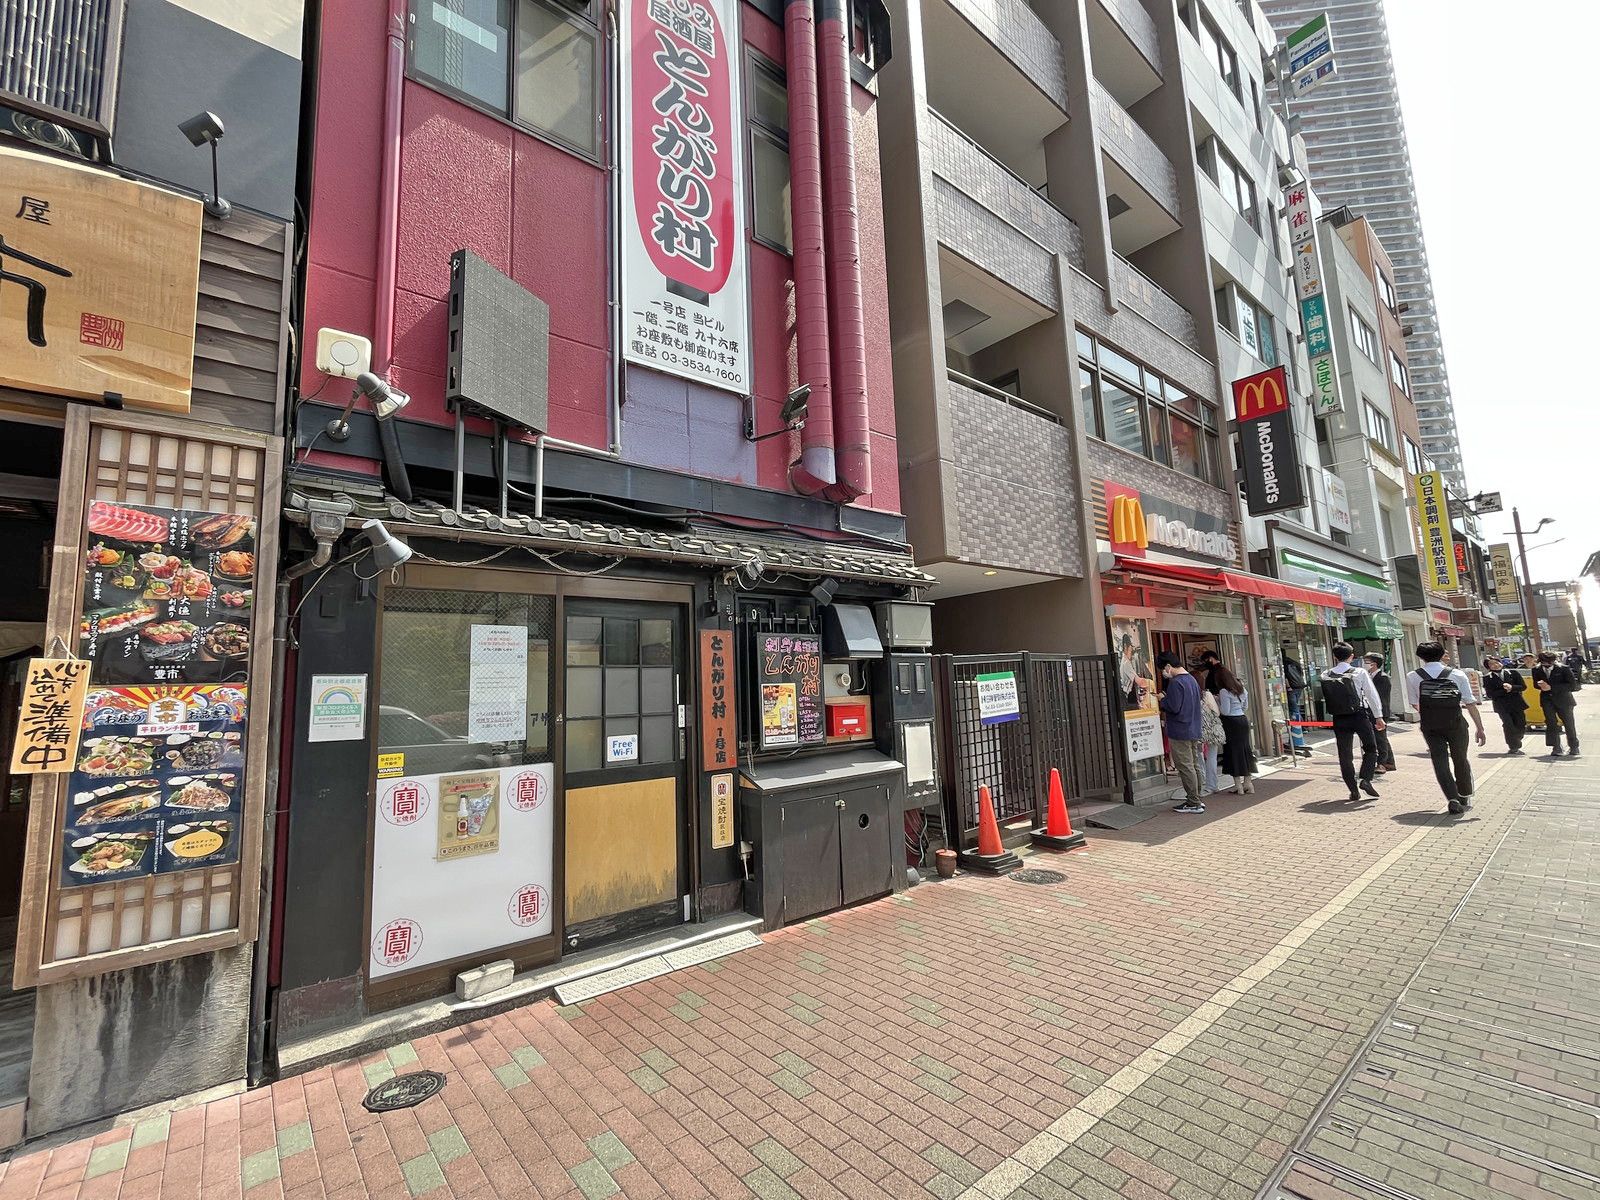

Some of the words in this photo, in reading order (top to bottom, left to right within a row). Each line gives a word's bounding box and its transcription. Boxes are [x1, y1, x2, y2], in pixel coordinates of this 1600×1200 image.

[1299, 78, 1314, 90] ATM
[652, 32, 716, 270] とんがり村
[16, 195, 52, 226] 屋
[1288, 188, 1308, 229] 麻雀
[1295, 229, 1310, 241] 2F
[633, 311, 689, 337] 一階、二階
[695, 328, 740, 354] 九十六席
[650, 300, 686, 320] 一号店
[693, 312, 725, 333] 当ビル
[1306, 314, 1327, 347] 歯科
[631, 340, 657, 359] 電話
[661, 350, 742, 383] 03-3534-1600
[636, 324, 737, 367] お座敷も御座います
[1313, 345, 1326, 355] 3F
[1328, 403, 1340, 412] 2F
[1257, 421, 1279, 504] McDonald's
[1422, 486, 1440, 526] 日本調剤
[1429, 527, 1450, 587] 豊洲駅前薬局
[711, 635, 726, 720] とんがり村
[764, 653, 820, 677] とんがり
[800, 675, 821, 697] 村
[104, 712, 142, 724] お昼の
[140, 724, 198, 734] 平日ランチ限定
[21, 700, 74, 771] 準備中
[612, 740, 633, 749] Free
[612, 747, 633, 757] Wi-Fi
